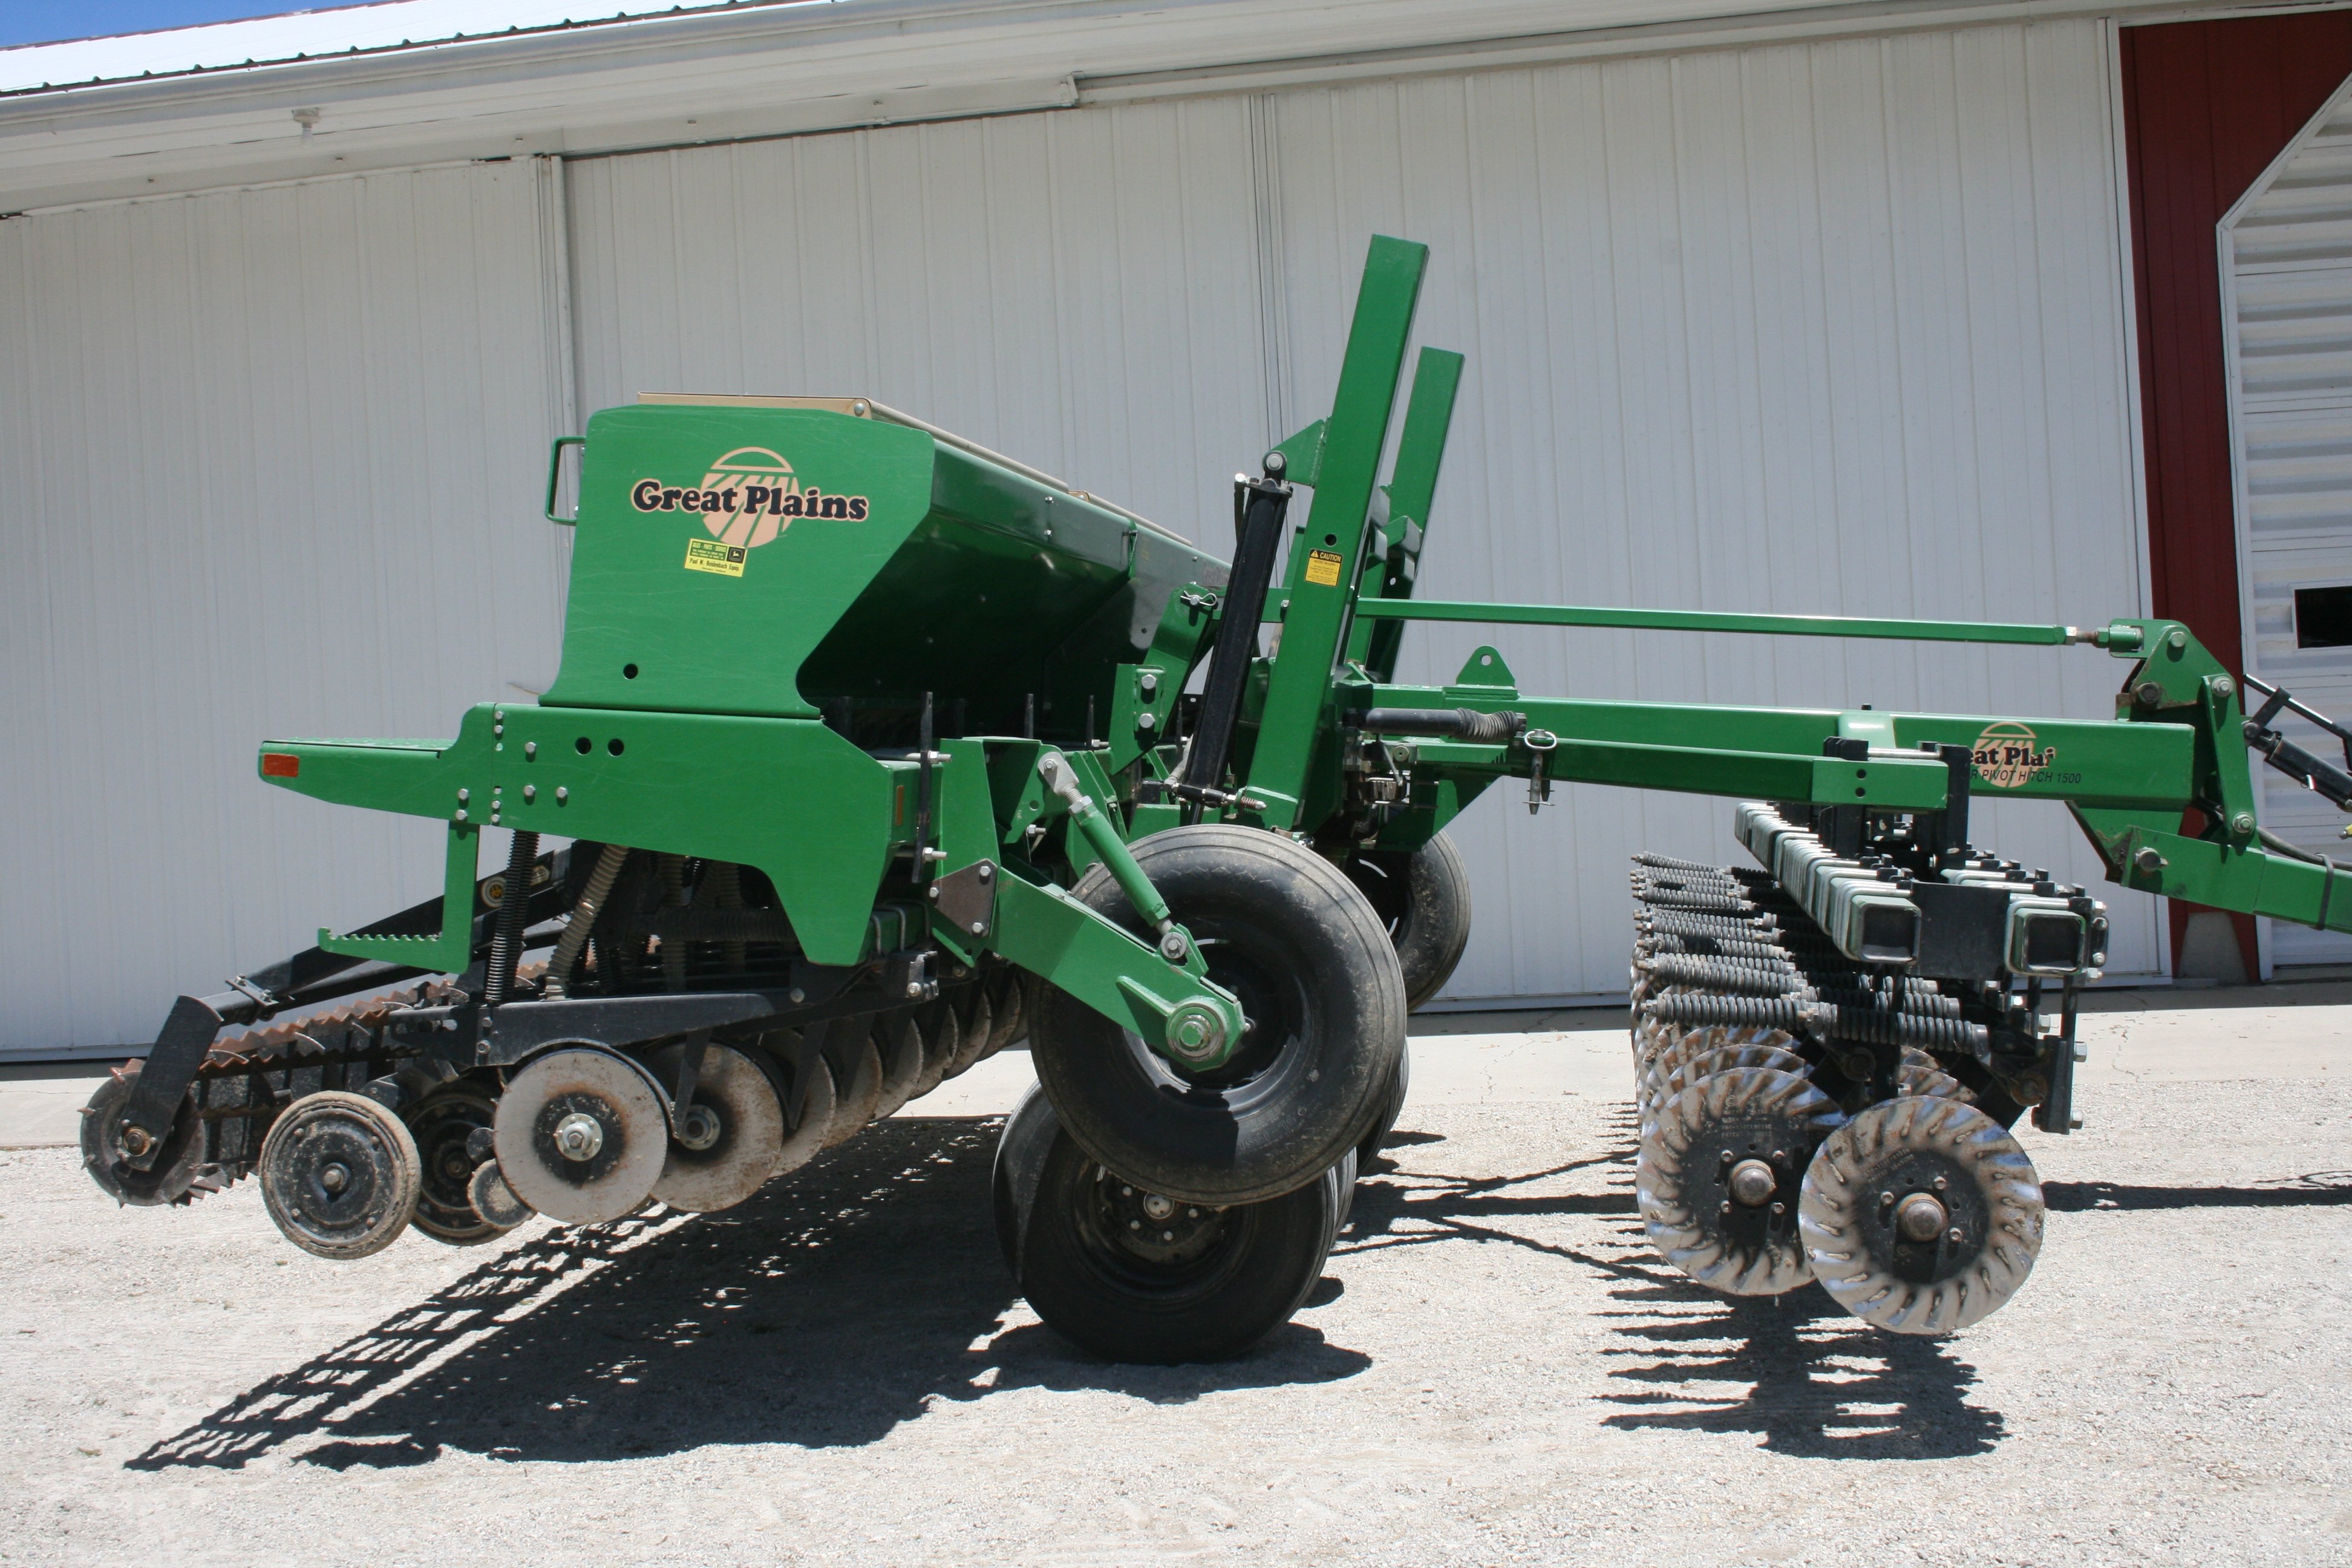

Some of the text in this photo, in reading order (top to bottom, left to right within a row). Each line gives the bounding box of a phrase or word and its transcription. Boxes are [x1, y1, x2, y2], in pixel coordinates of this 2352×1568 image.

[633, 481, 867, 520] Great Plains
[1320, 552, 1341, 561] CAUTION
[1982, 769, 2016, 781] PIVOT
[2018, 771, 2053, 782] HITCH
[2057, 773, 2082, 783] 1500
